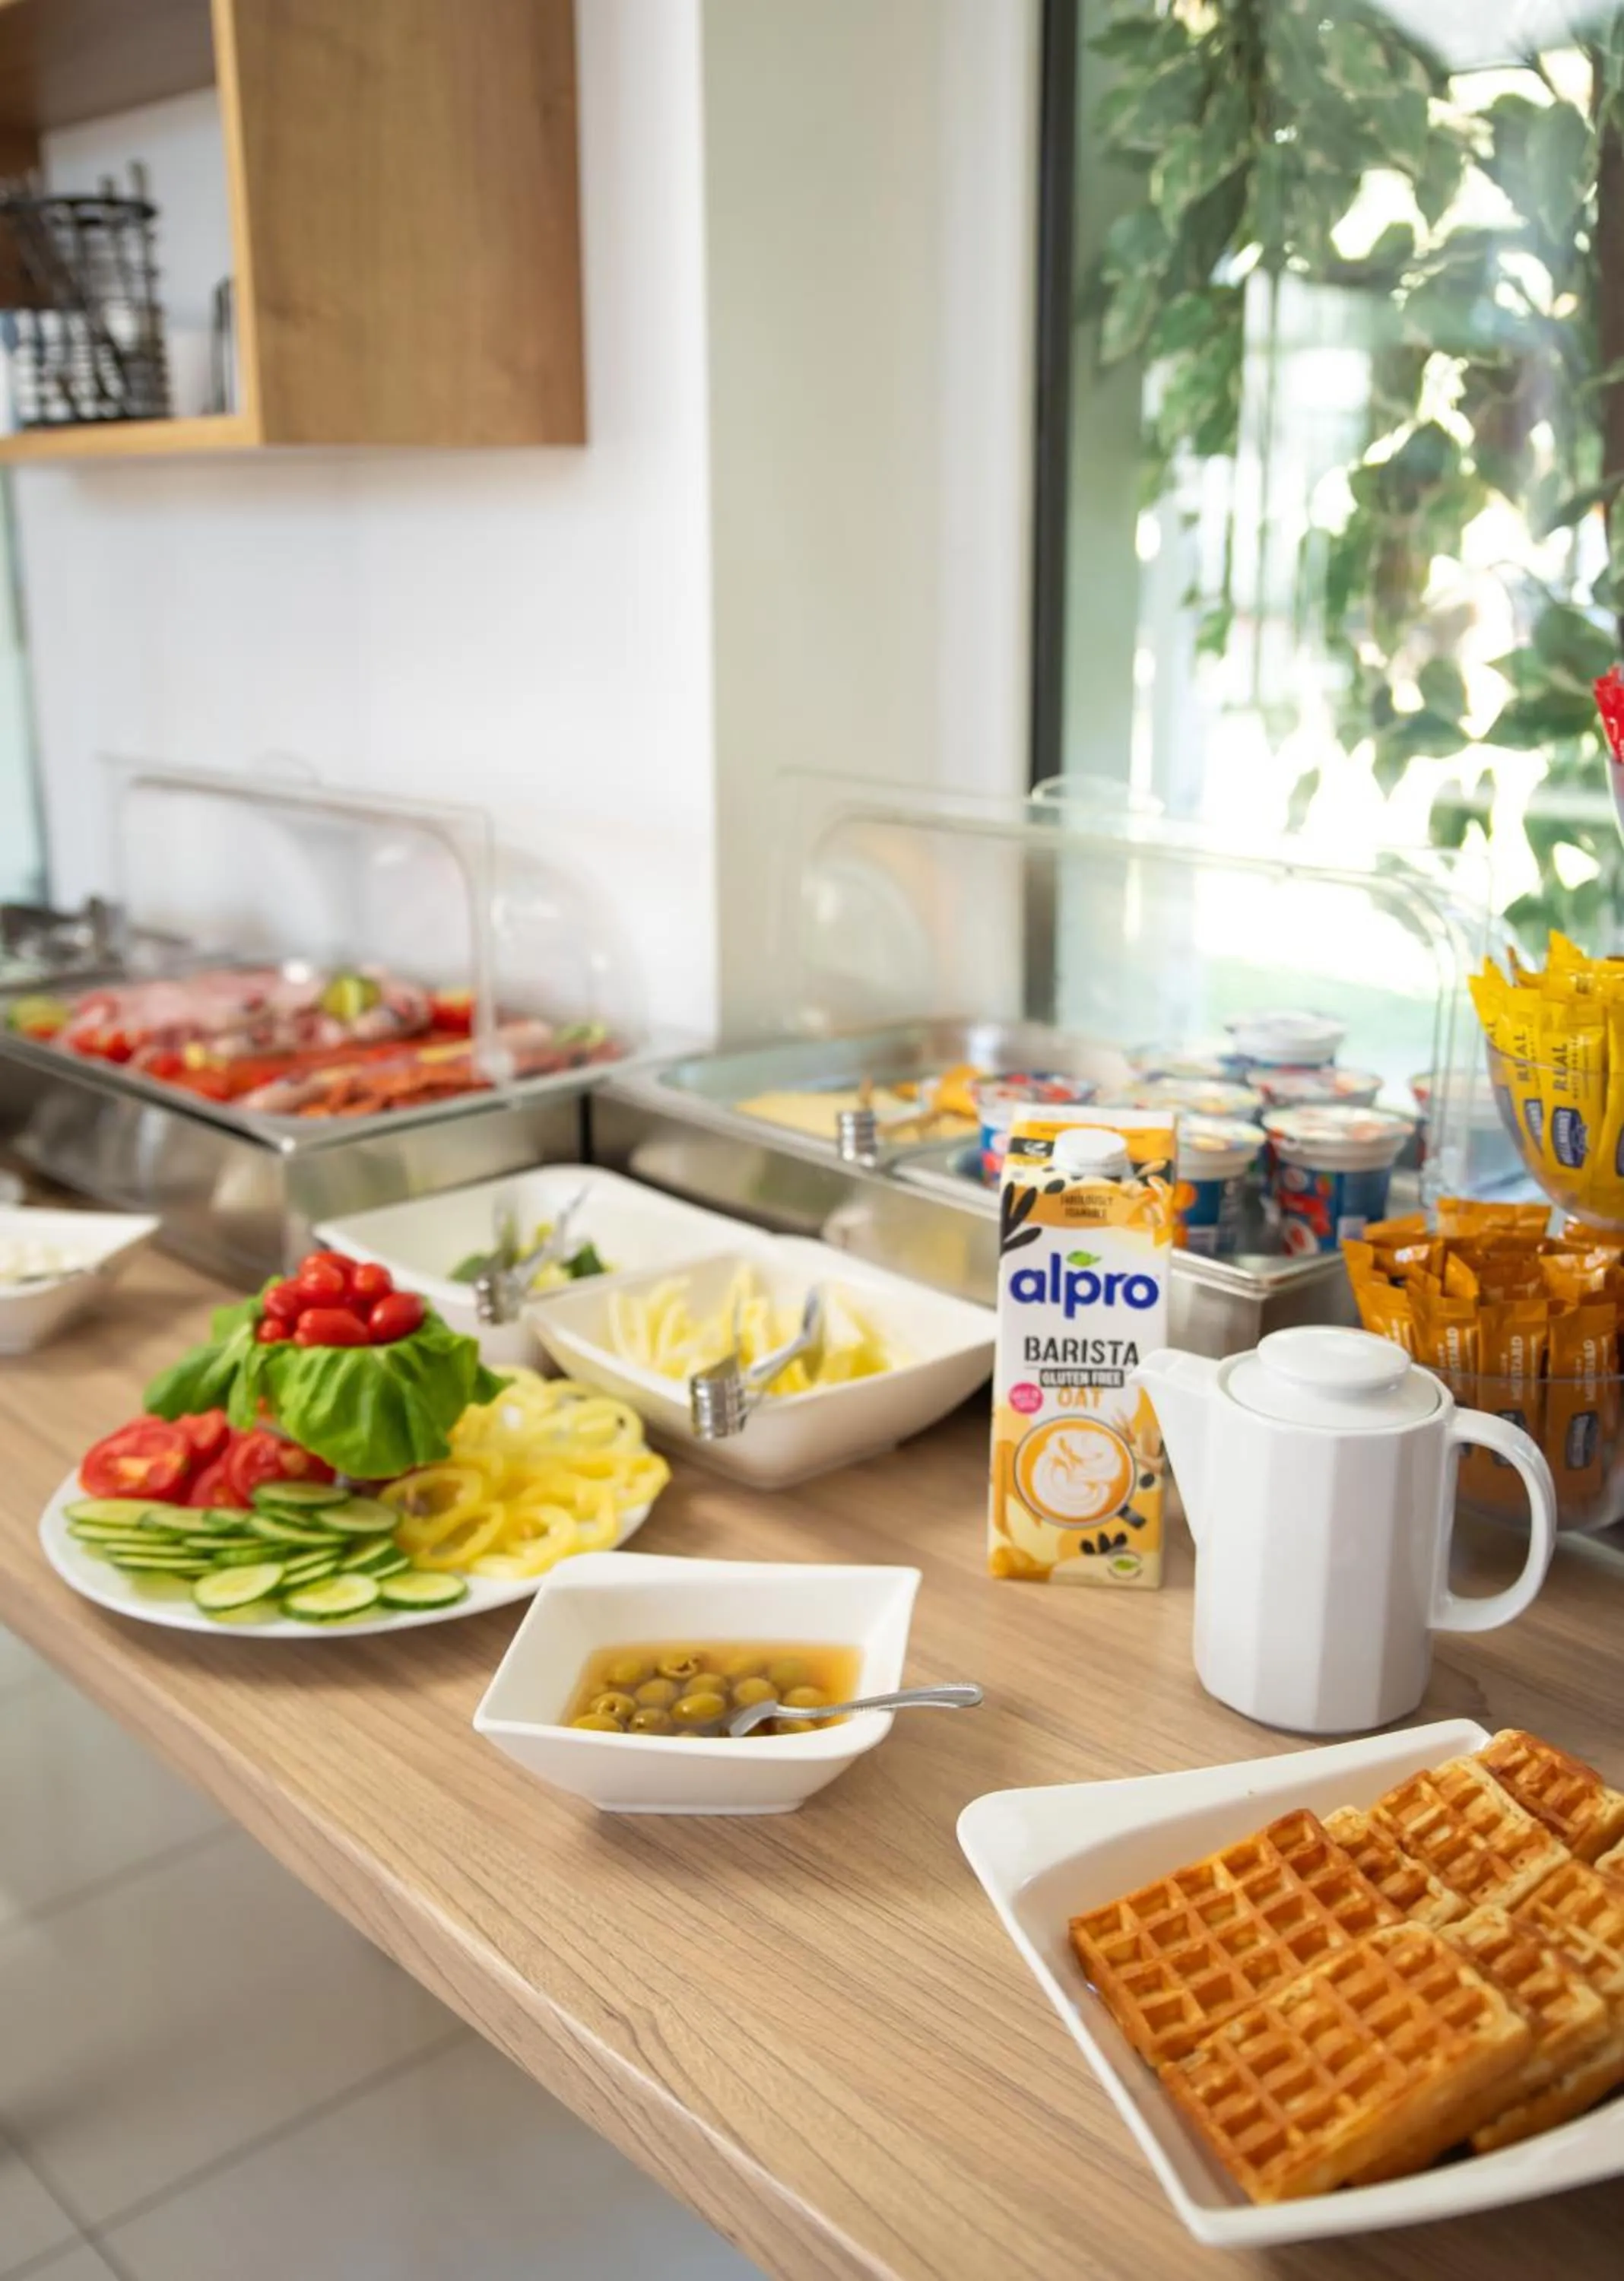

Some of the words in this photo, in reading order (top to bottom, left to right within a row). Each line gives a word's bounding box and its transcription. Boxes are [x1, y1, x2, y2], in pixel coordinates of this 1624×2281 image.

[1514, 1035, 1532, 1083] REAL
[1552, 1043, 1568, 1092] REAL
[1009, 1251, 1159, 1319] alpro
[1023, 1336, 1140, 1368] BARISTA
[1041, 1369, 1090, 1385] GLUTEN
[1092, 1370, 1122, 1386] FREE
[1058, 1385, 1103, 1409] OAT
